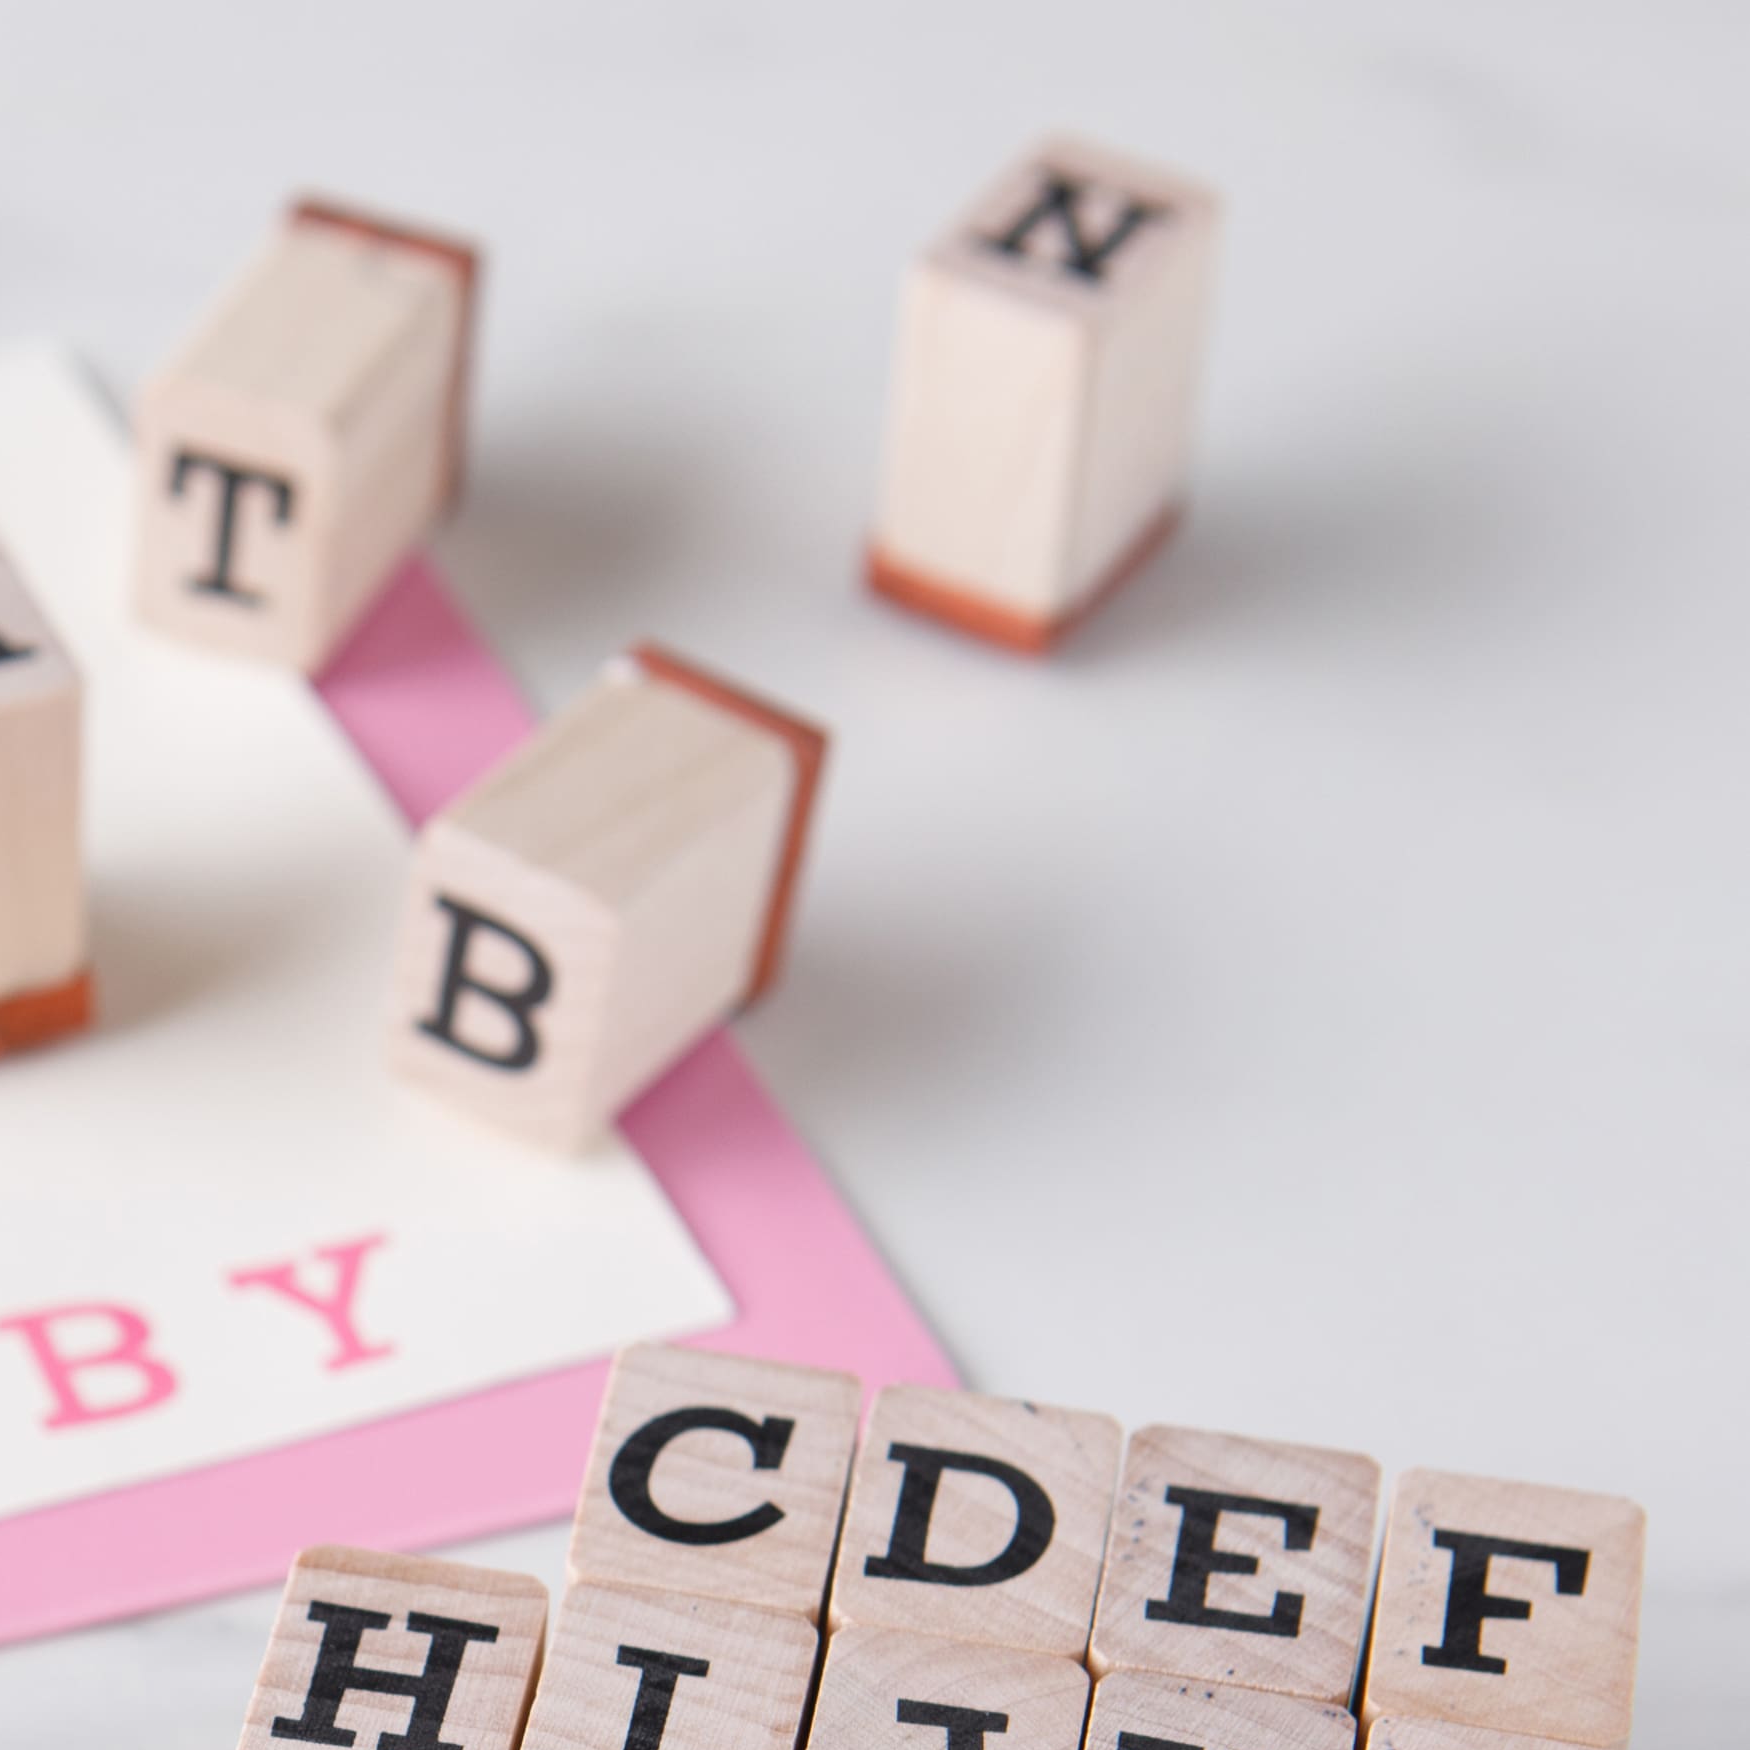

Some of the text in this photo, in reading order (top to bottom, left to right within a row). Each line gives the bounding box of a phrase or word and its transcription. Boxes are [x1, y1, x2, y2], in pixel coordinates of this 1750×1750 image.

[975, 168, 1165, 283] N
[170, 447, 297, 605] T
[417, 892, 558, 1072] B
[610, 1408, 794, 1545] C
[865, 1443, 1054, 1586] D
[1146, 1486, 1318, 1638] E
[1424, 1530, 1589, 1674] F
